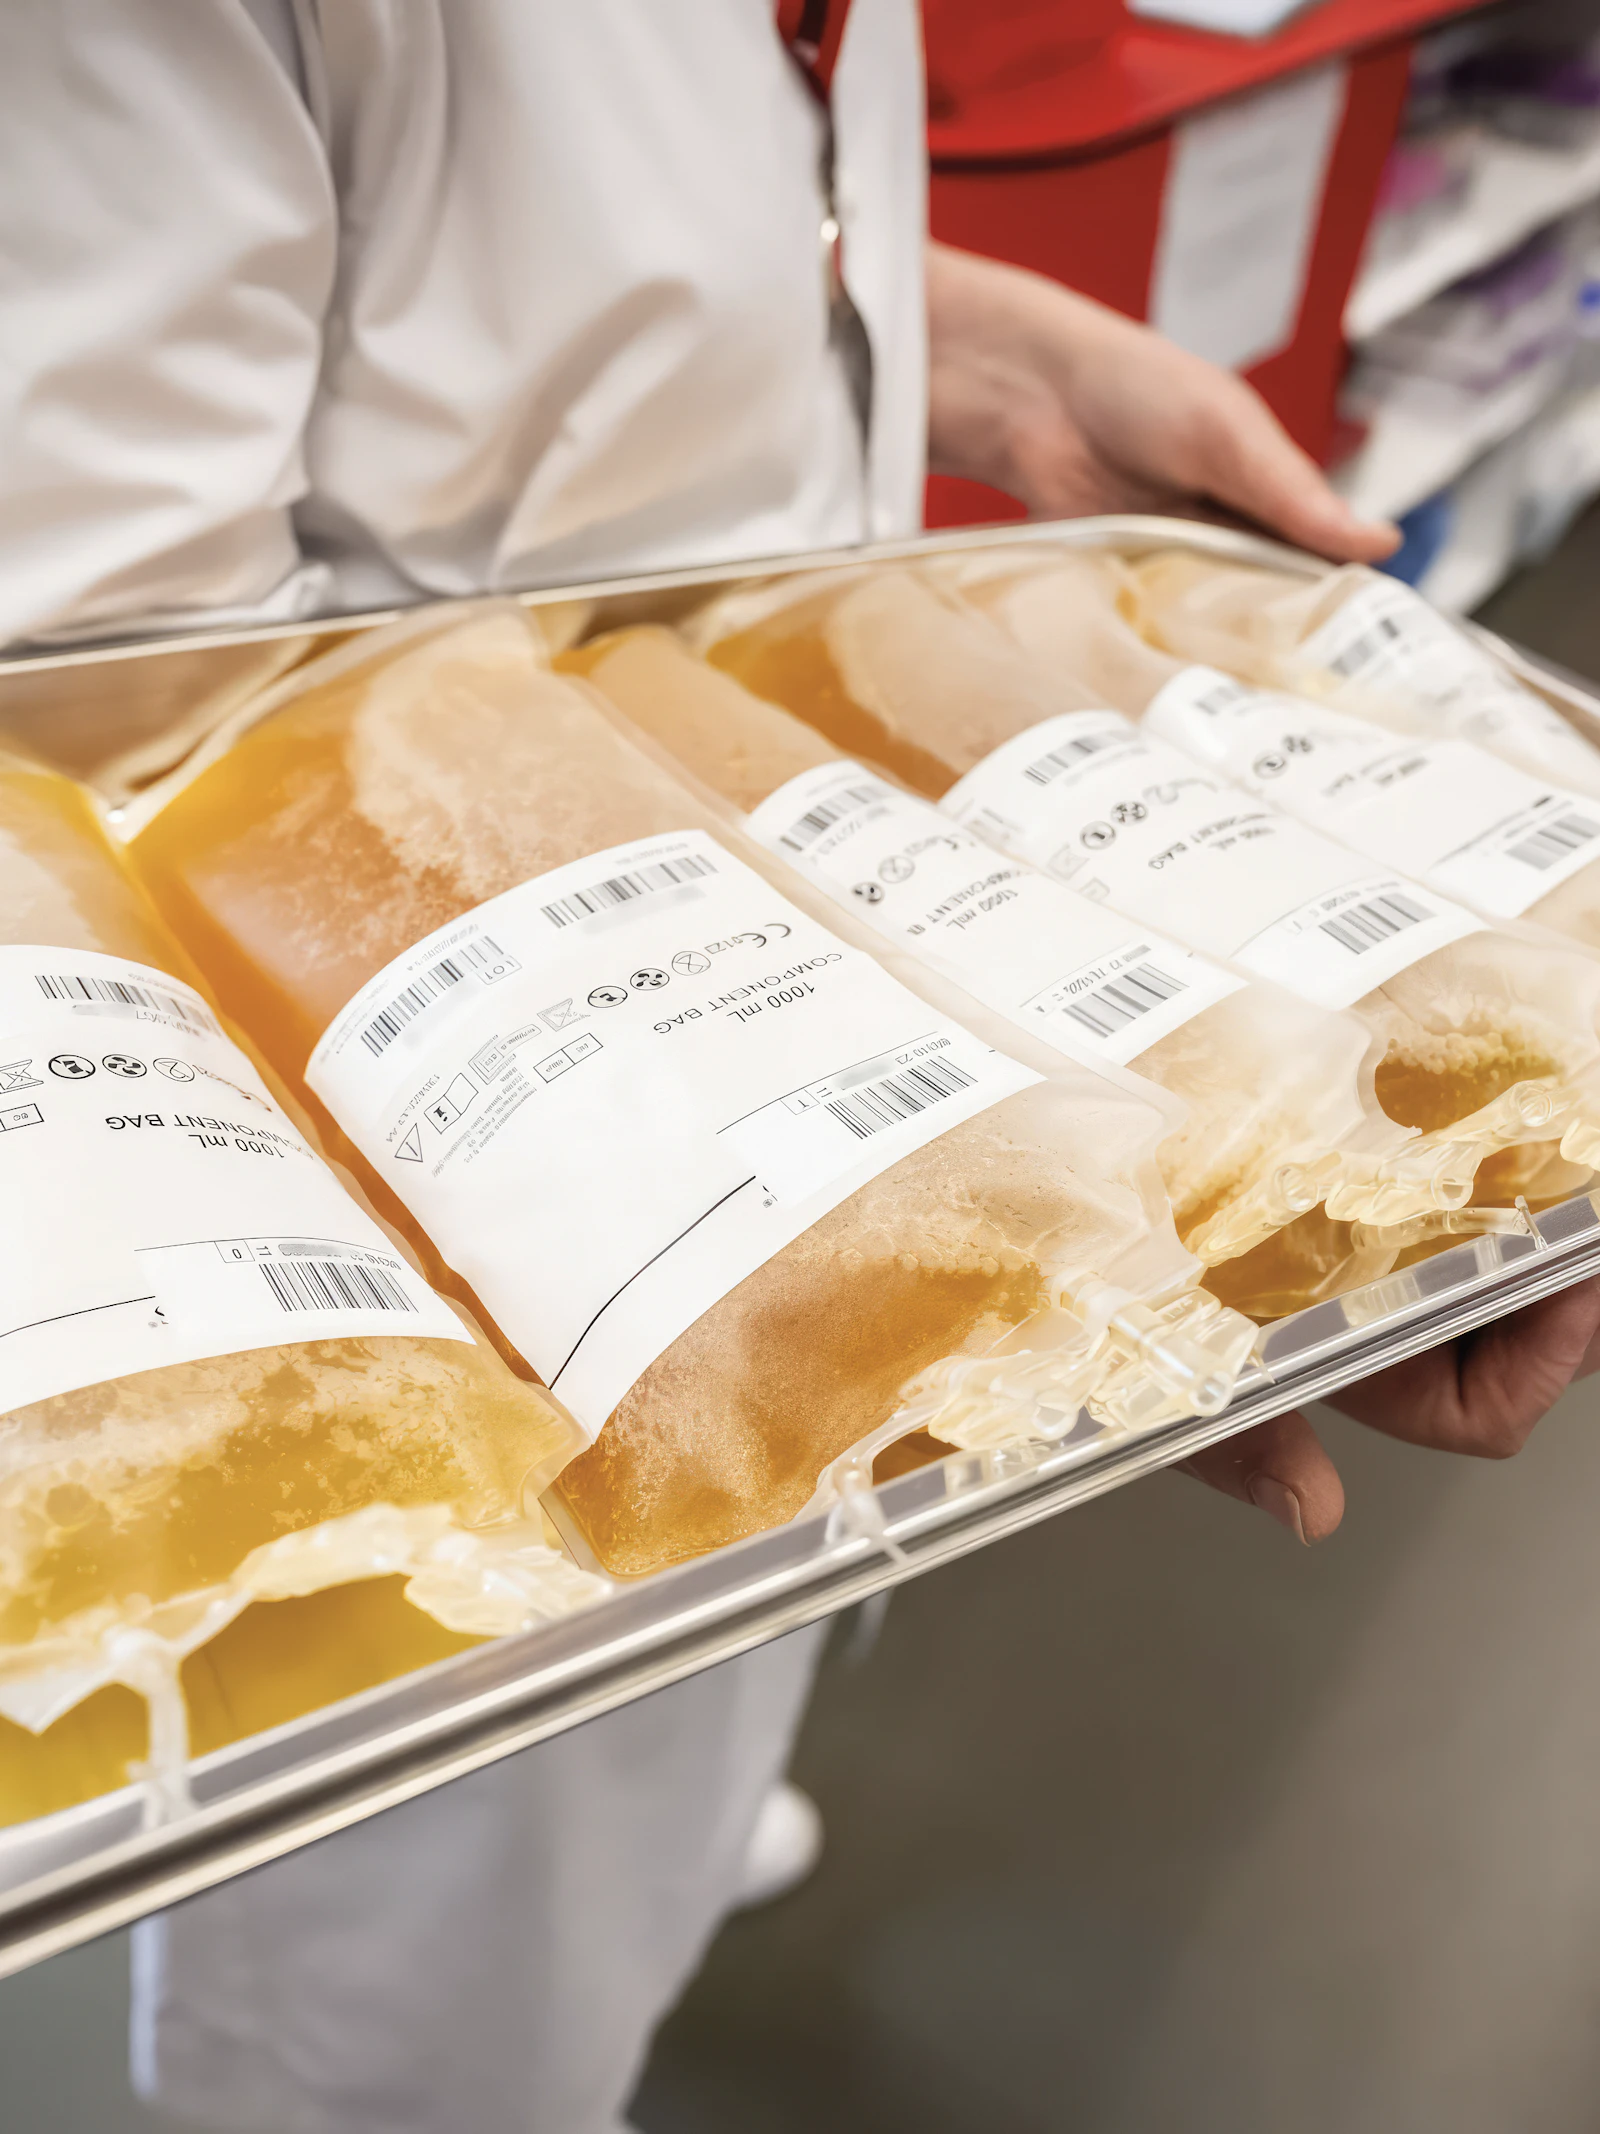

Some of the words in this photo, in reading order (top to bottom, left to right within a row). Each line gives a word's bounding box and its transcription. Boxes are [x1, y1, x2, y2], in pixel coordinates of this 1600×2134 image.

[708, 953, 842, 1012] COMPONENT
[766, 981, 815, 1009] 1000
[653, 1008, 703, 1034] BAG
[726, 1002, 763, 1023] mL
[105, 1114, 165, 1130] BAG
[188, 1134, 228, 1149] mL
[235, 1138, 285, 1158] 1000
